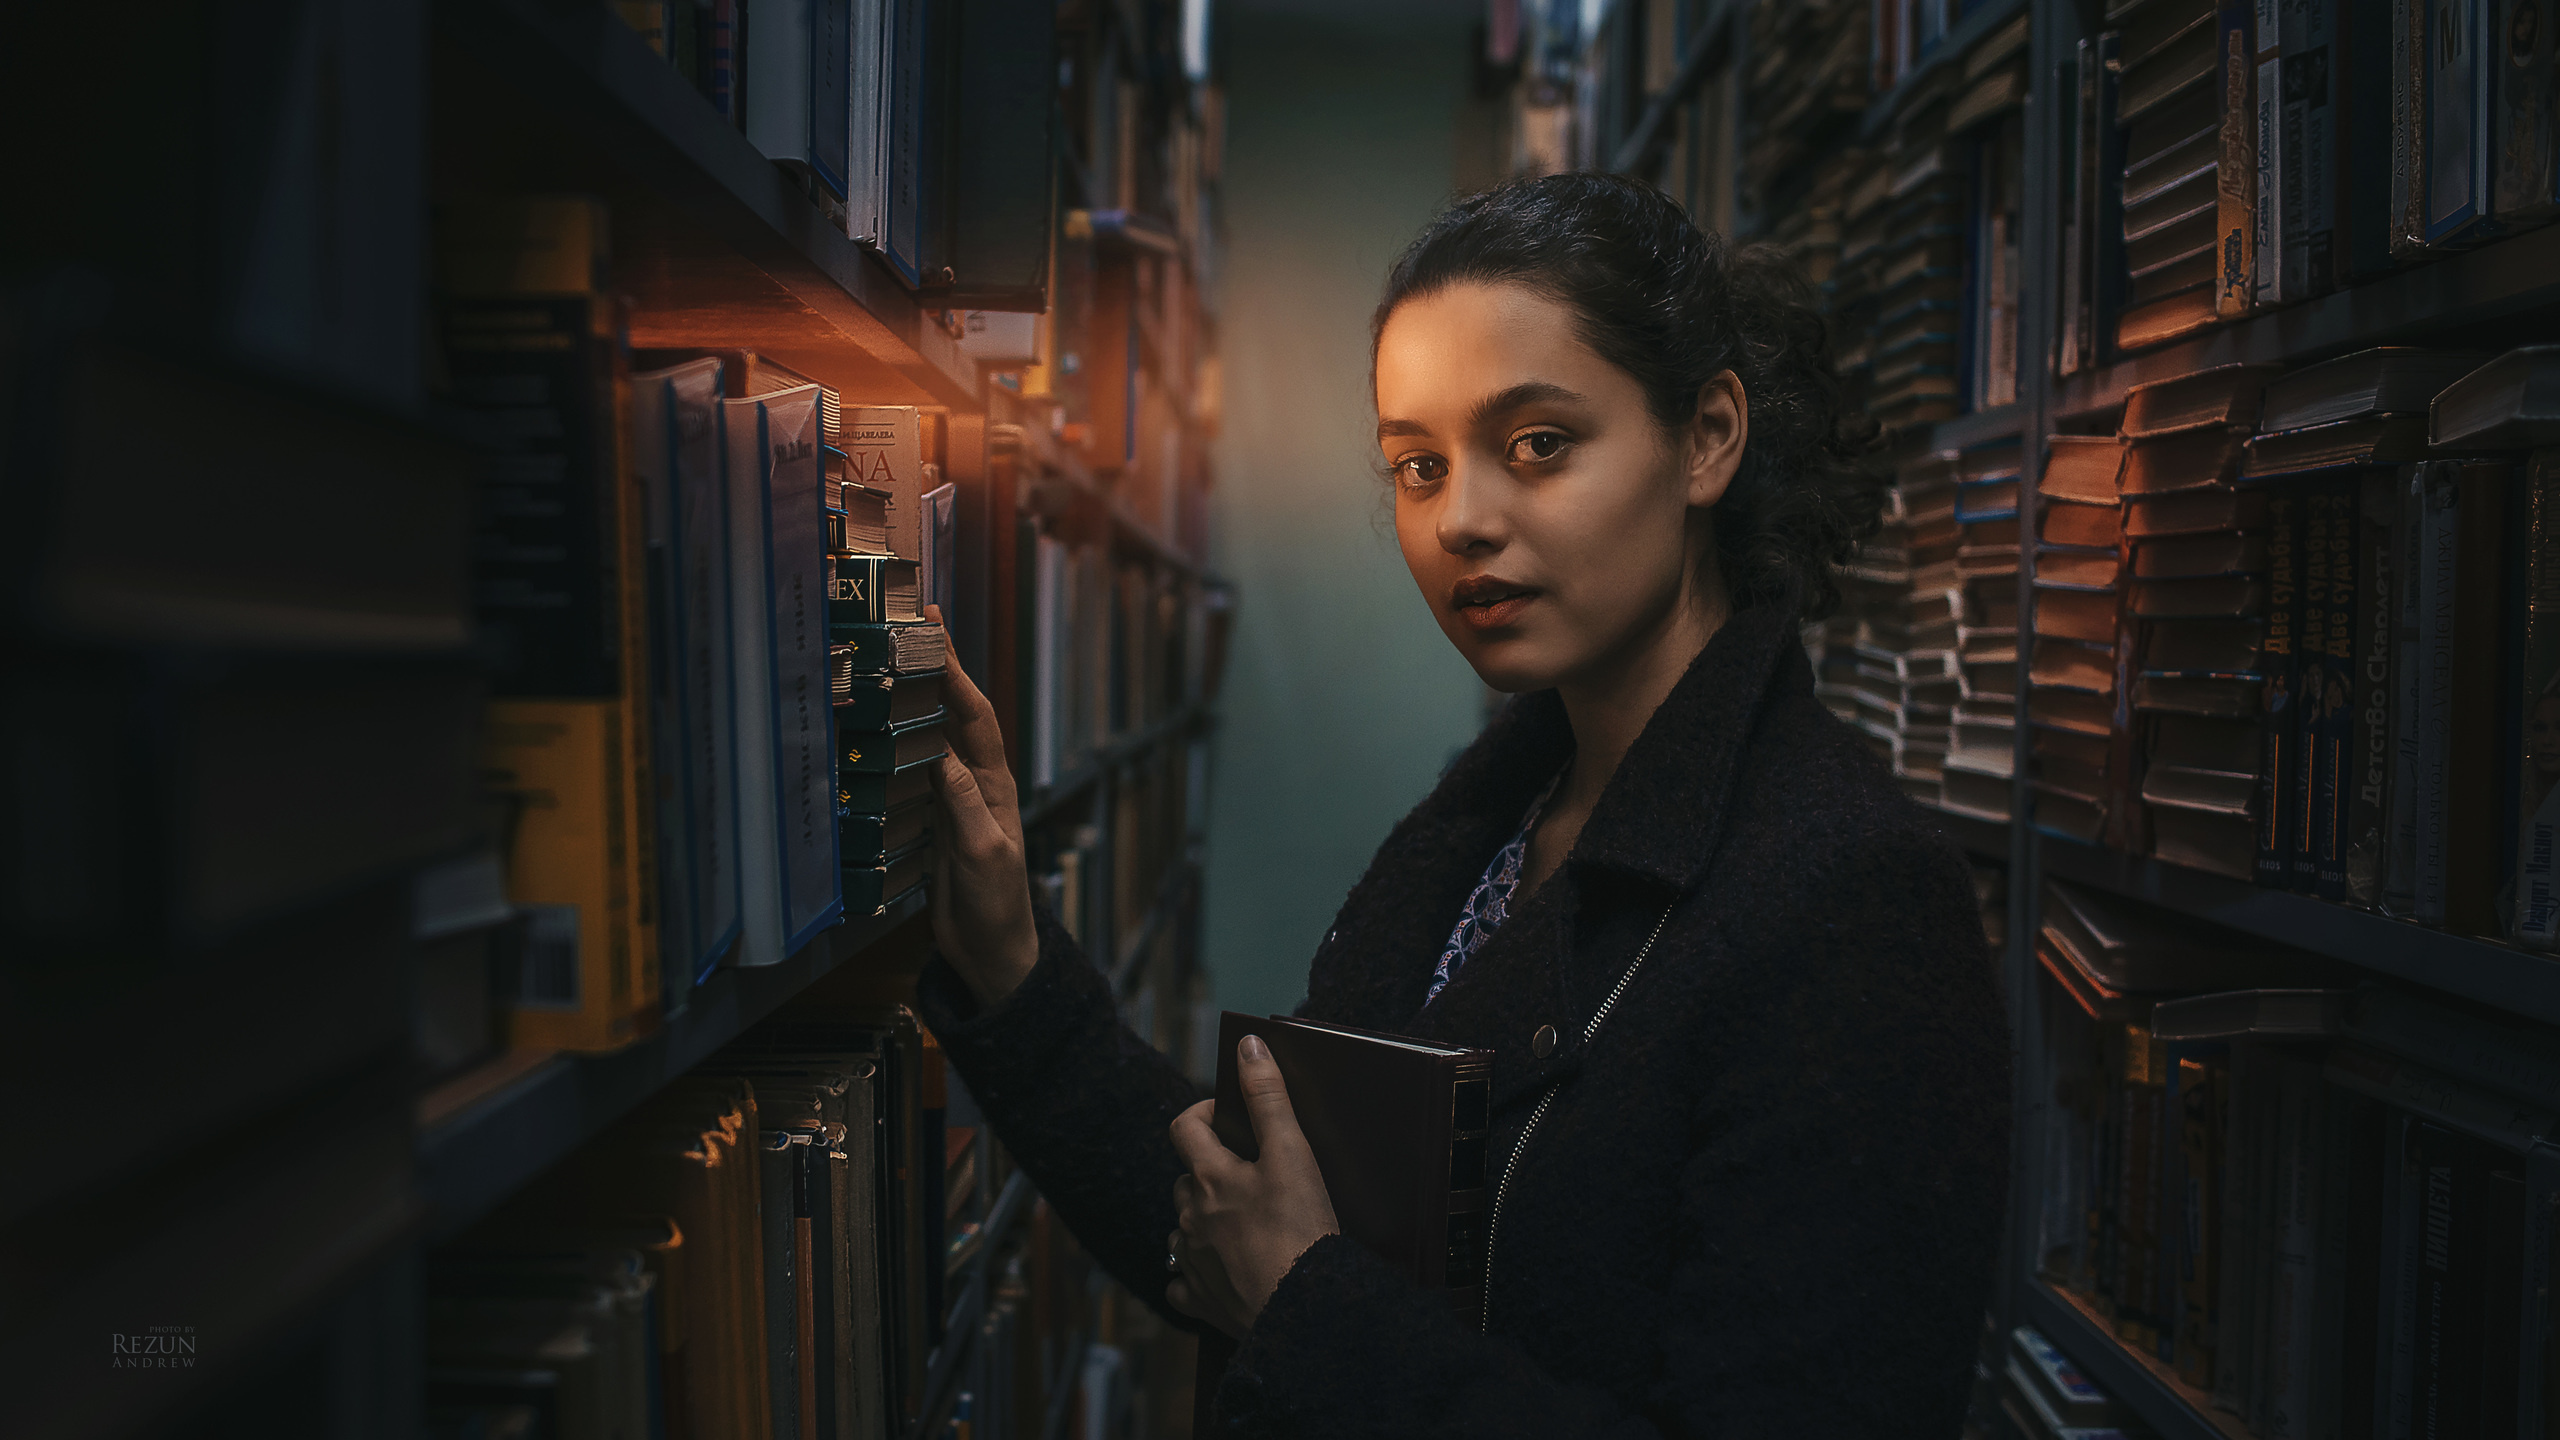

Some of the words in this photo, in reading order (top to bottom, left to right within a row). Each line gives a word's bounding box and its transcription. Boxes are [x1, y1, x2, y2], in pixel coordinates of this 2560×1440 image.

[2268, 498, 2295, 605] судьбы-4
[2304, 493, 2329, 602] судьбы-3
[2328, 493, 2354, 604] судьбы-2
[2436, 526, 2453, 598] ДЖИЛЛ
[2264, 611, 2291, 655] Две
[2302, 608, 2326, 653] Две
[2326, 611, 2351, 659] Две
[2433, 600, 2452, 709] МЭНСЕЛЛ
[2360, 688, 2387, 808] Детство
[2427, 760, 2443, 836] ТОЛЬКО
[2427, 841, 2441, 868] ТЫ
[2427, 873, 2440, 887] И
[2525, 821, 2554, 876] Макнот
[2426, 893, 2438, 905] Я
[2426, 1165, 2454, 1272] НИЩЕТА
